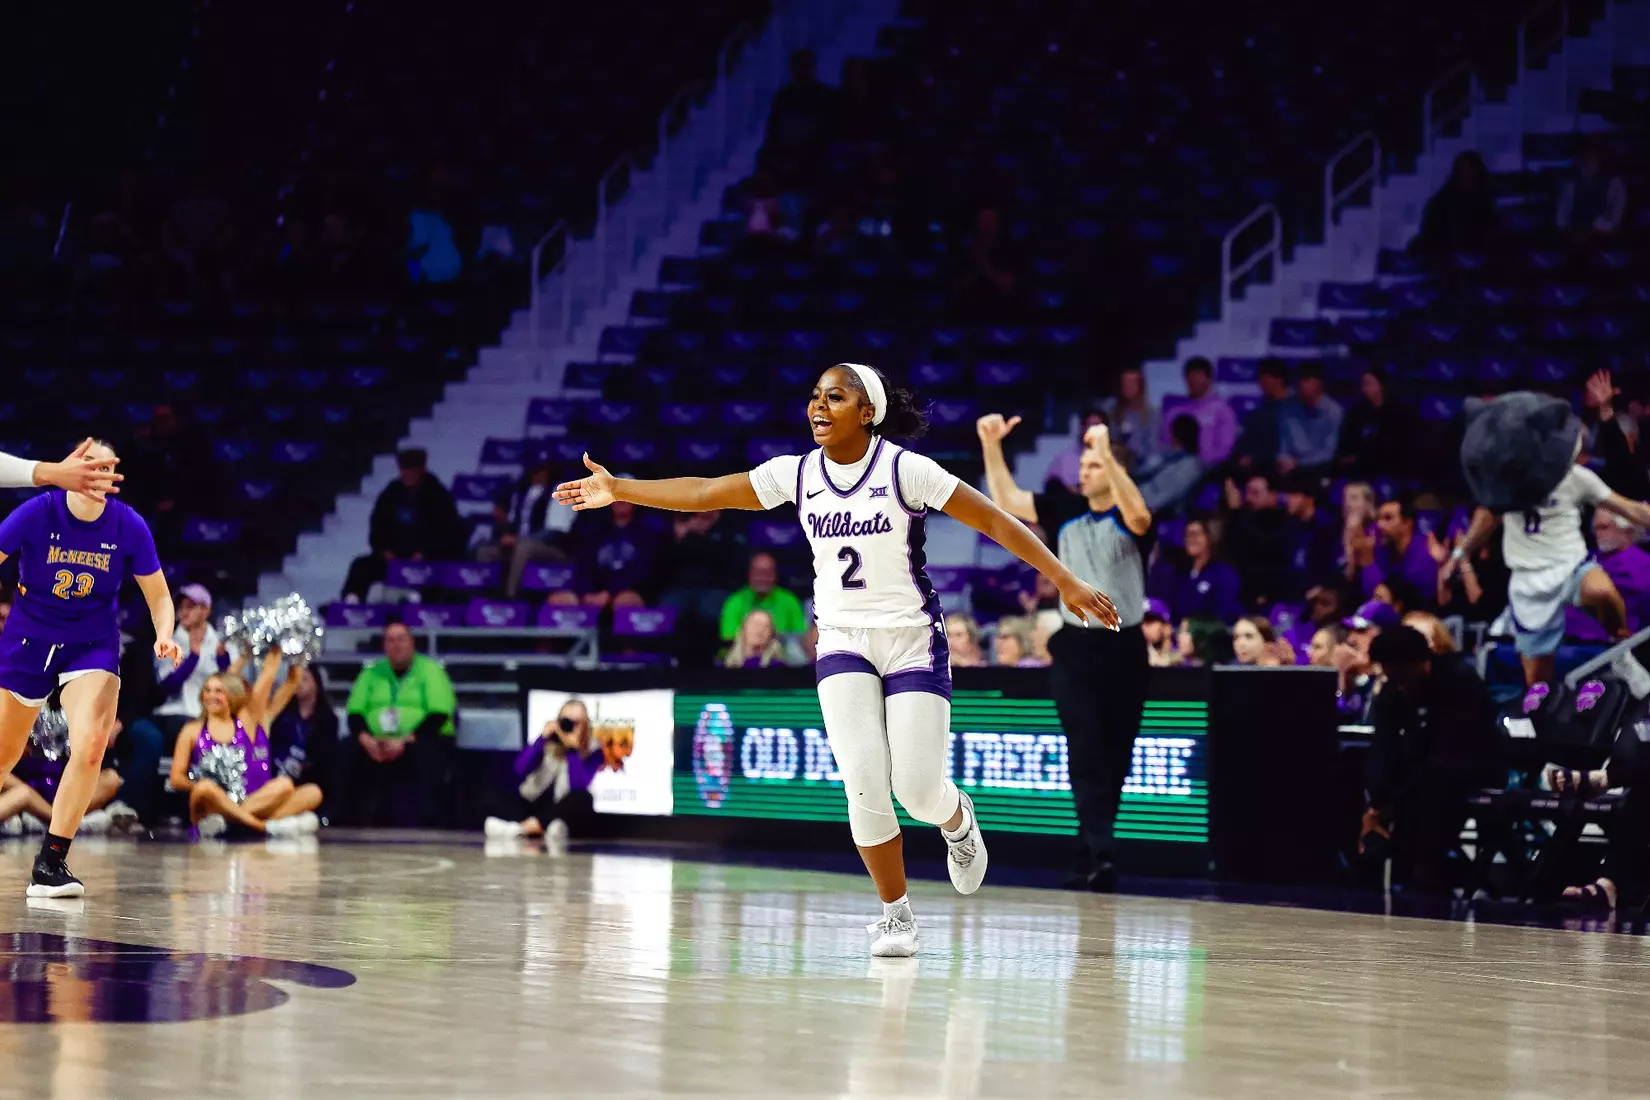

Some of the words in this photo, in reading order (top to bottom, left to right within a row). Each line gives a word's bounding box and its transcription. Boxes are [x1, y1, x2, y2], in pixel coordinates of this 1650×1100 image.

[808, 511, 893, 538] Wildcats
[52, 569, 94, 600] 23
[837, 546, 867, 590] 2
[962, 732, 1072, 790] FREIG
[1121, 737, 1195, 795] INE
